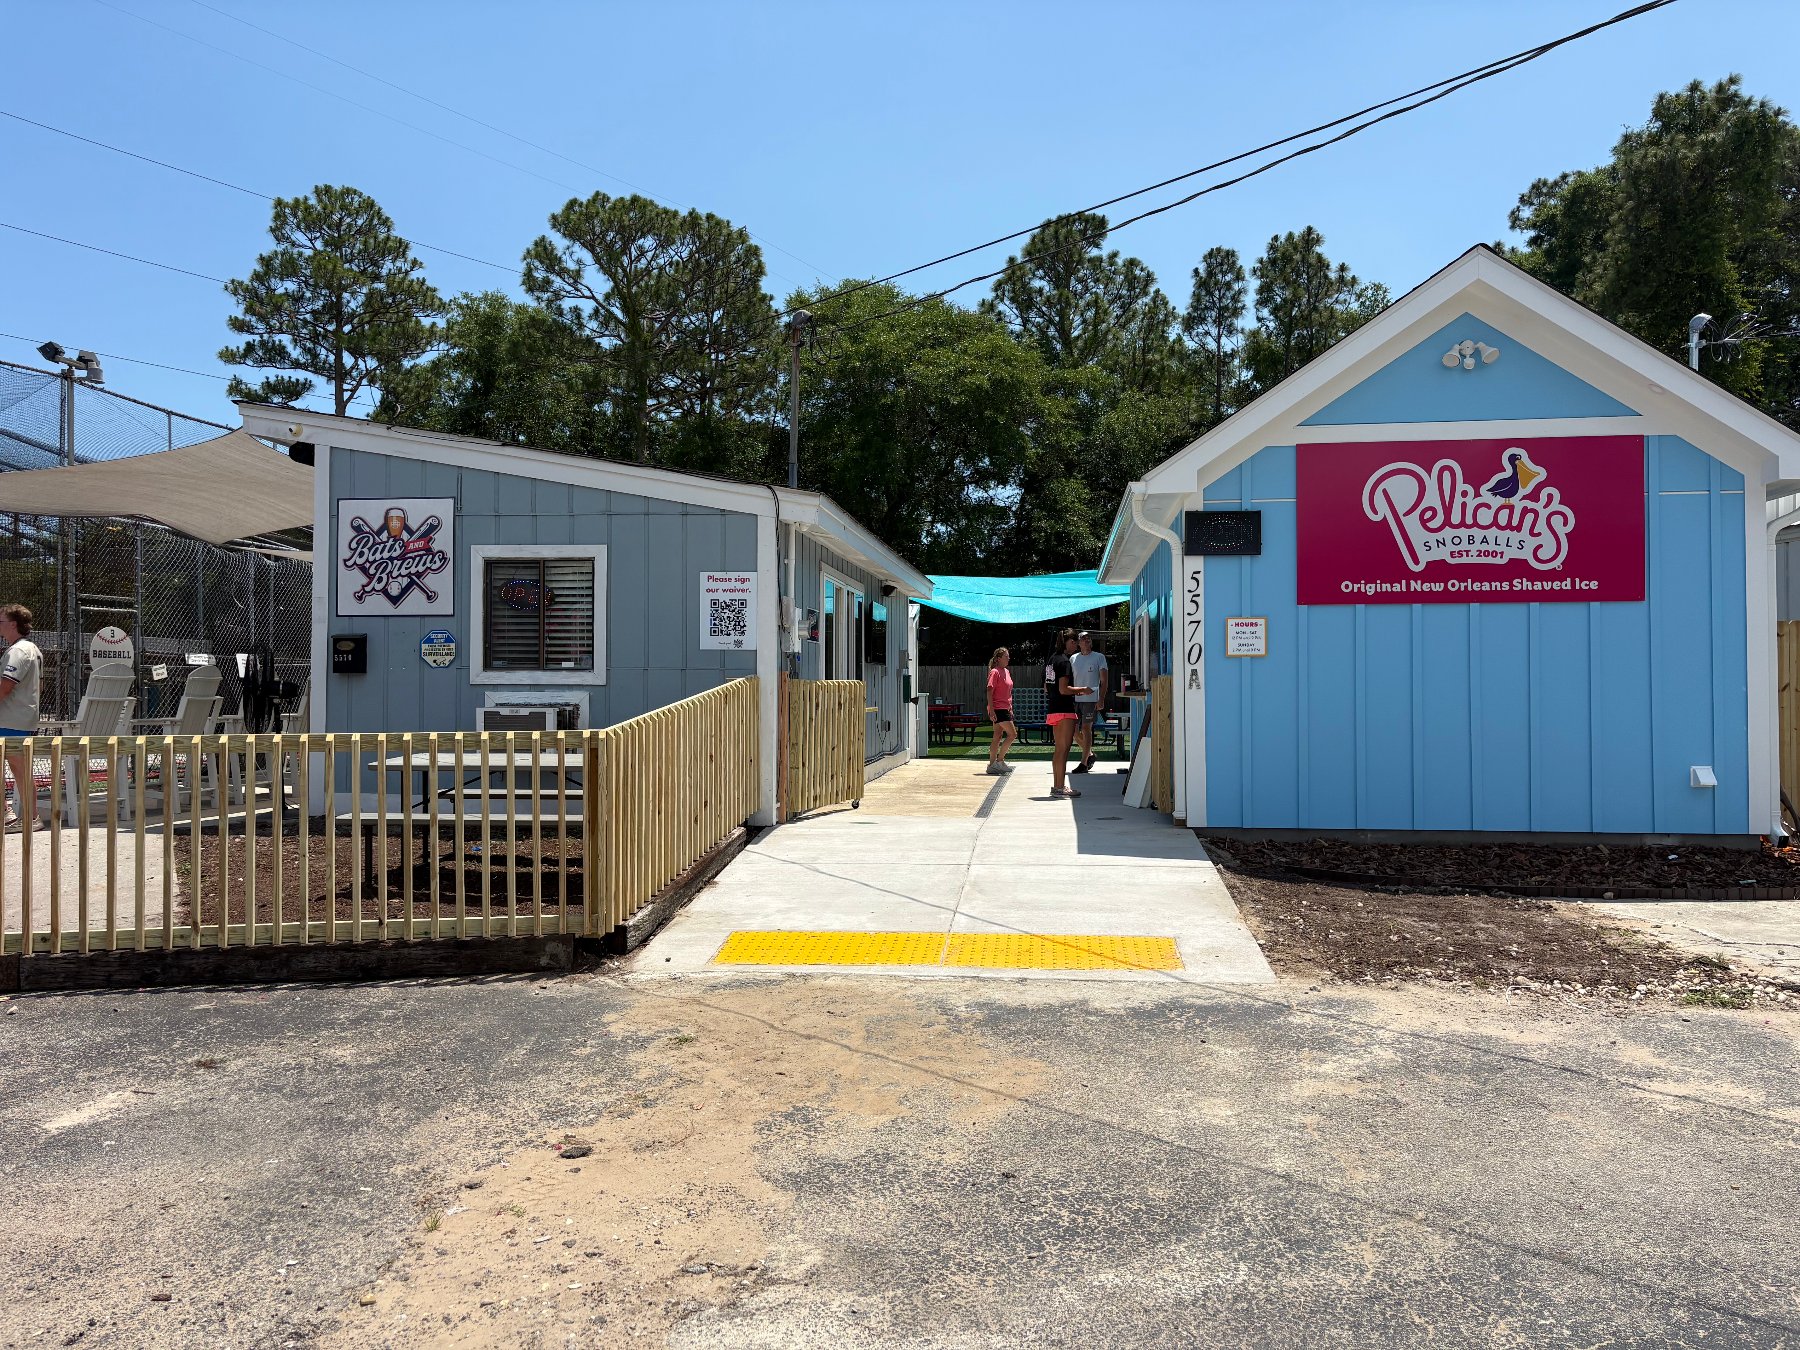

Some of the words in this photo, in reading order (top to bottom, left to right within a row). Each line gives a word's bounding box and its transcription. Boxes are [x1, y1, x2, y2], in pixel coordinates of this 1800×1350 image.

[1366, 462, 1571, 568] Pelican's
[344, 533, 405, 567] Bats
[407, 540, 425, 550] AND
[1423, 534, 1526, 552] SNOBALLS
[1449, 549, 1474, 559] EST.
[1475, 549, 1505, 559] 2001
[363, 551, 445, 592] Brews
[734, 575, 750, 584] sign
[1340, 579, 1407, 596] Original
[1409, 579, 1445, 592] New
[1447, 578, 1510, 592] Orleans
[1512, 577, 1572, 592] Shaved
[1574, 577, 1599, 590] Ice
[110, 629, 115, 638] 3
[92, 649, 132, 659] BASEBALL
